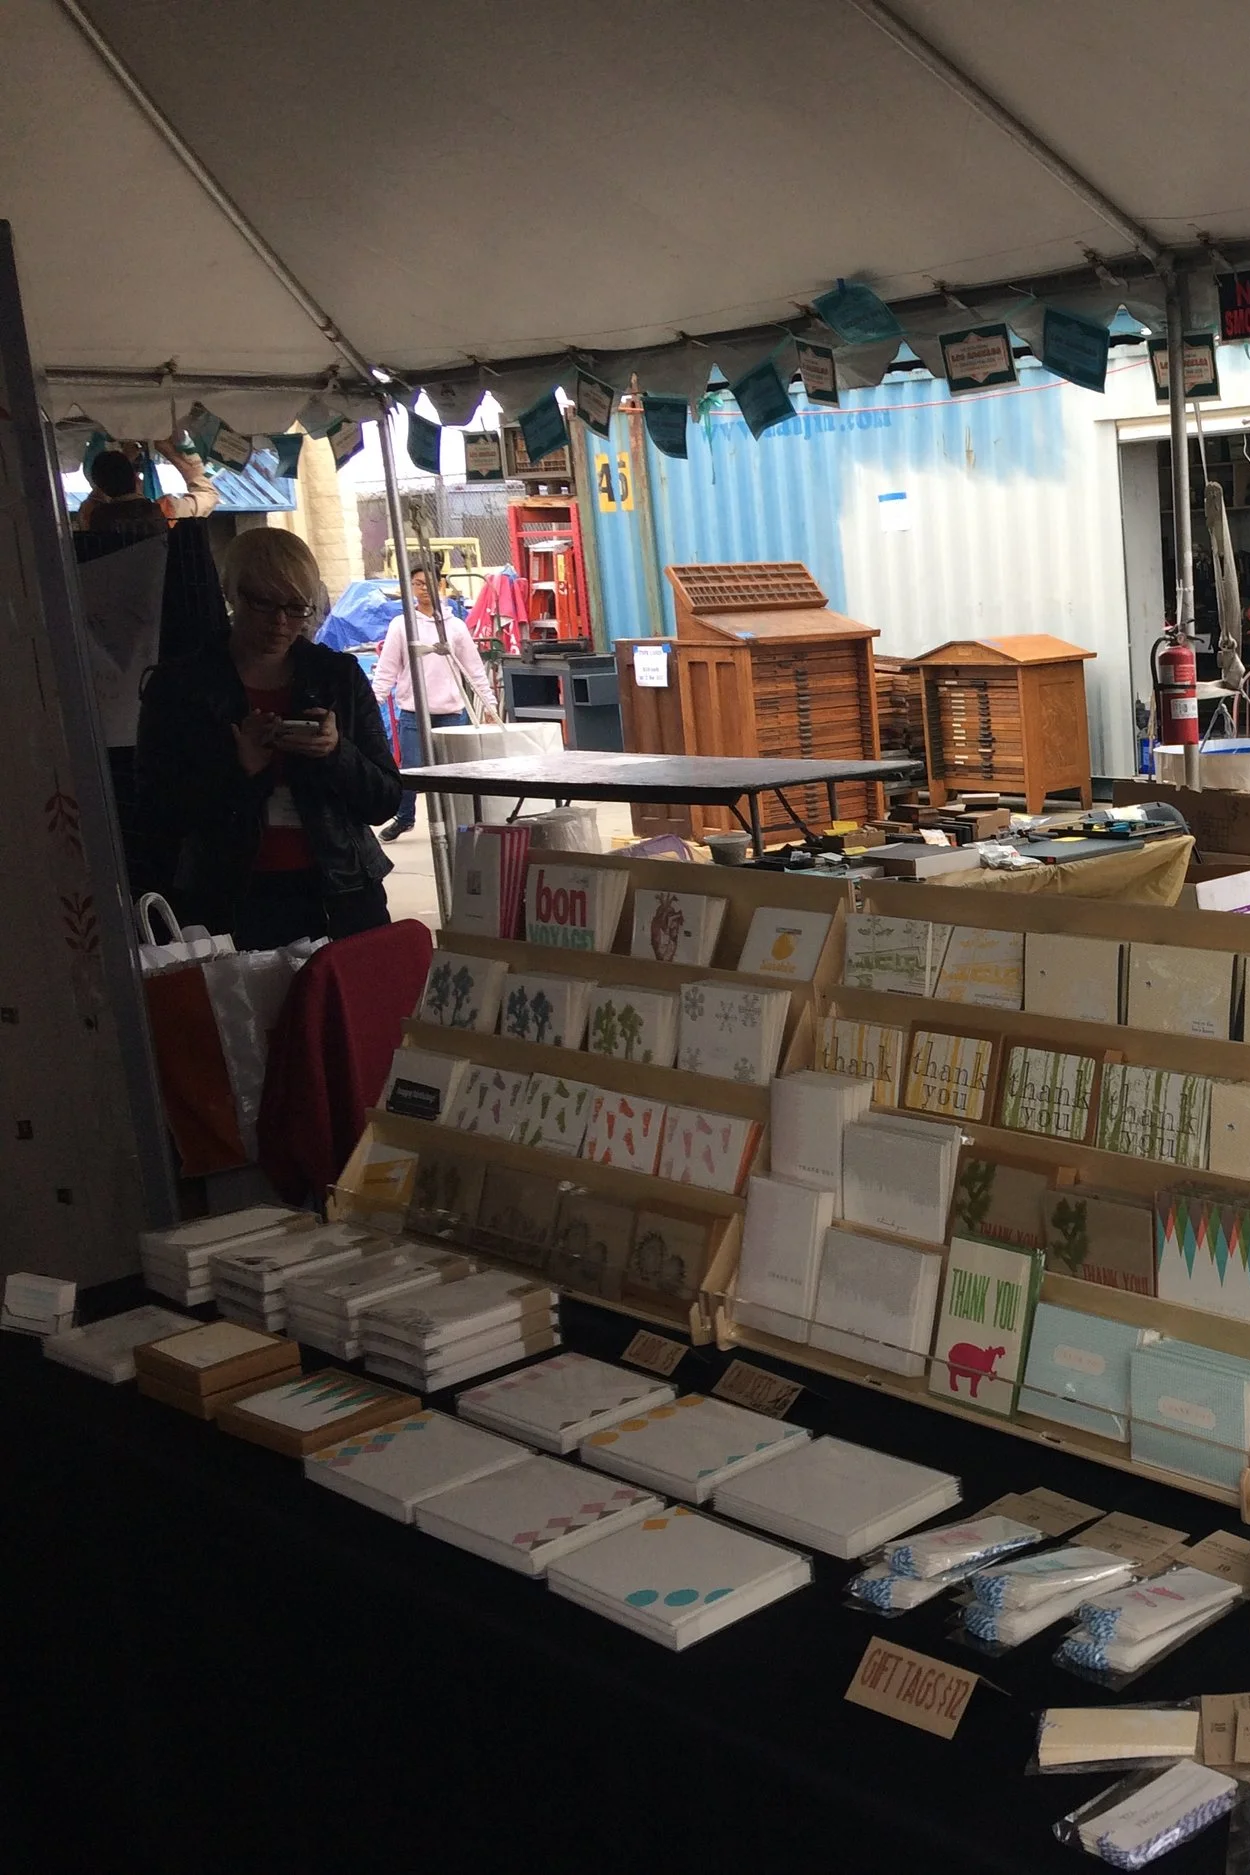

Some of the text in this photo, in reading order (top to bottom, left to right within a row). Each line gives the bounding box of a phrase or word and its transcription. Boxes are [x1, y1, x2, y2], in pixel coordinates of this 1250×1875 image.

[535, 869, 587, 928] bon
[913, 1041, 989, 1090] thank
[1009, 1061, 1091, 1110] thank
[923, 1083, 968, 1111] you
[1021, 1106, 1071, 1132] you
[1110, 1083, 1197, 1136] thank
[1123, 1130, 1176, 1159] you
[949, 1267, 992, 1324] THANK
[860, 1647, 904, 1694] GIFT
[896, 1660, 946, 1712] TAGS
